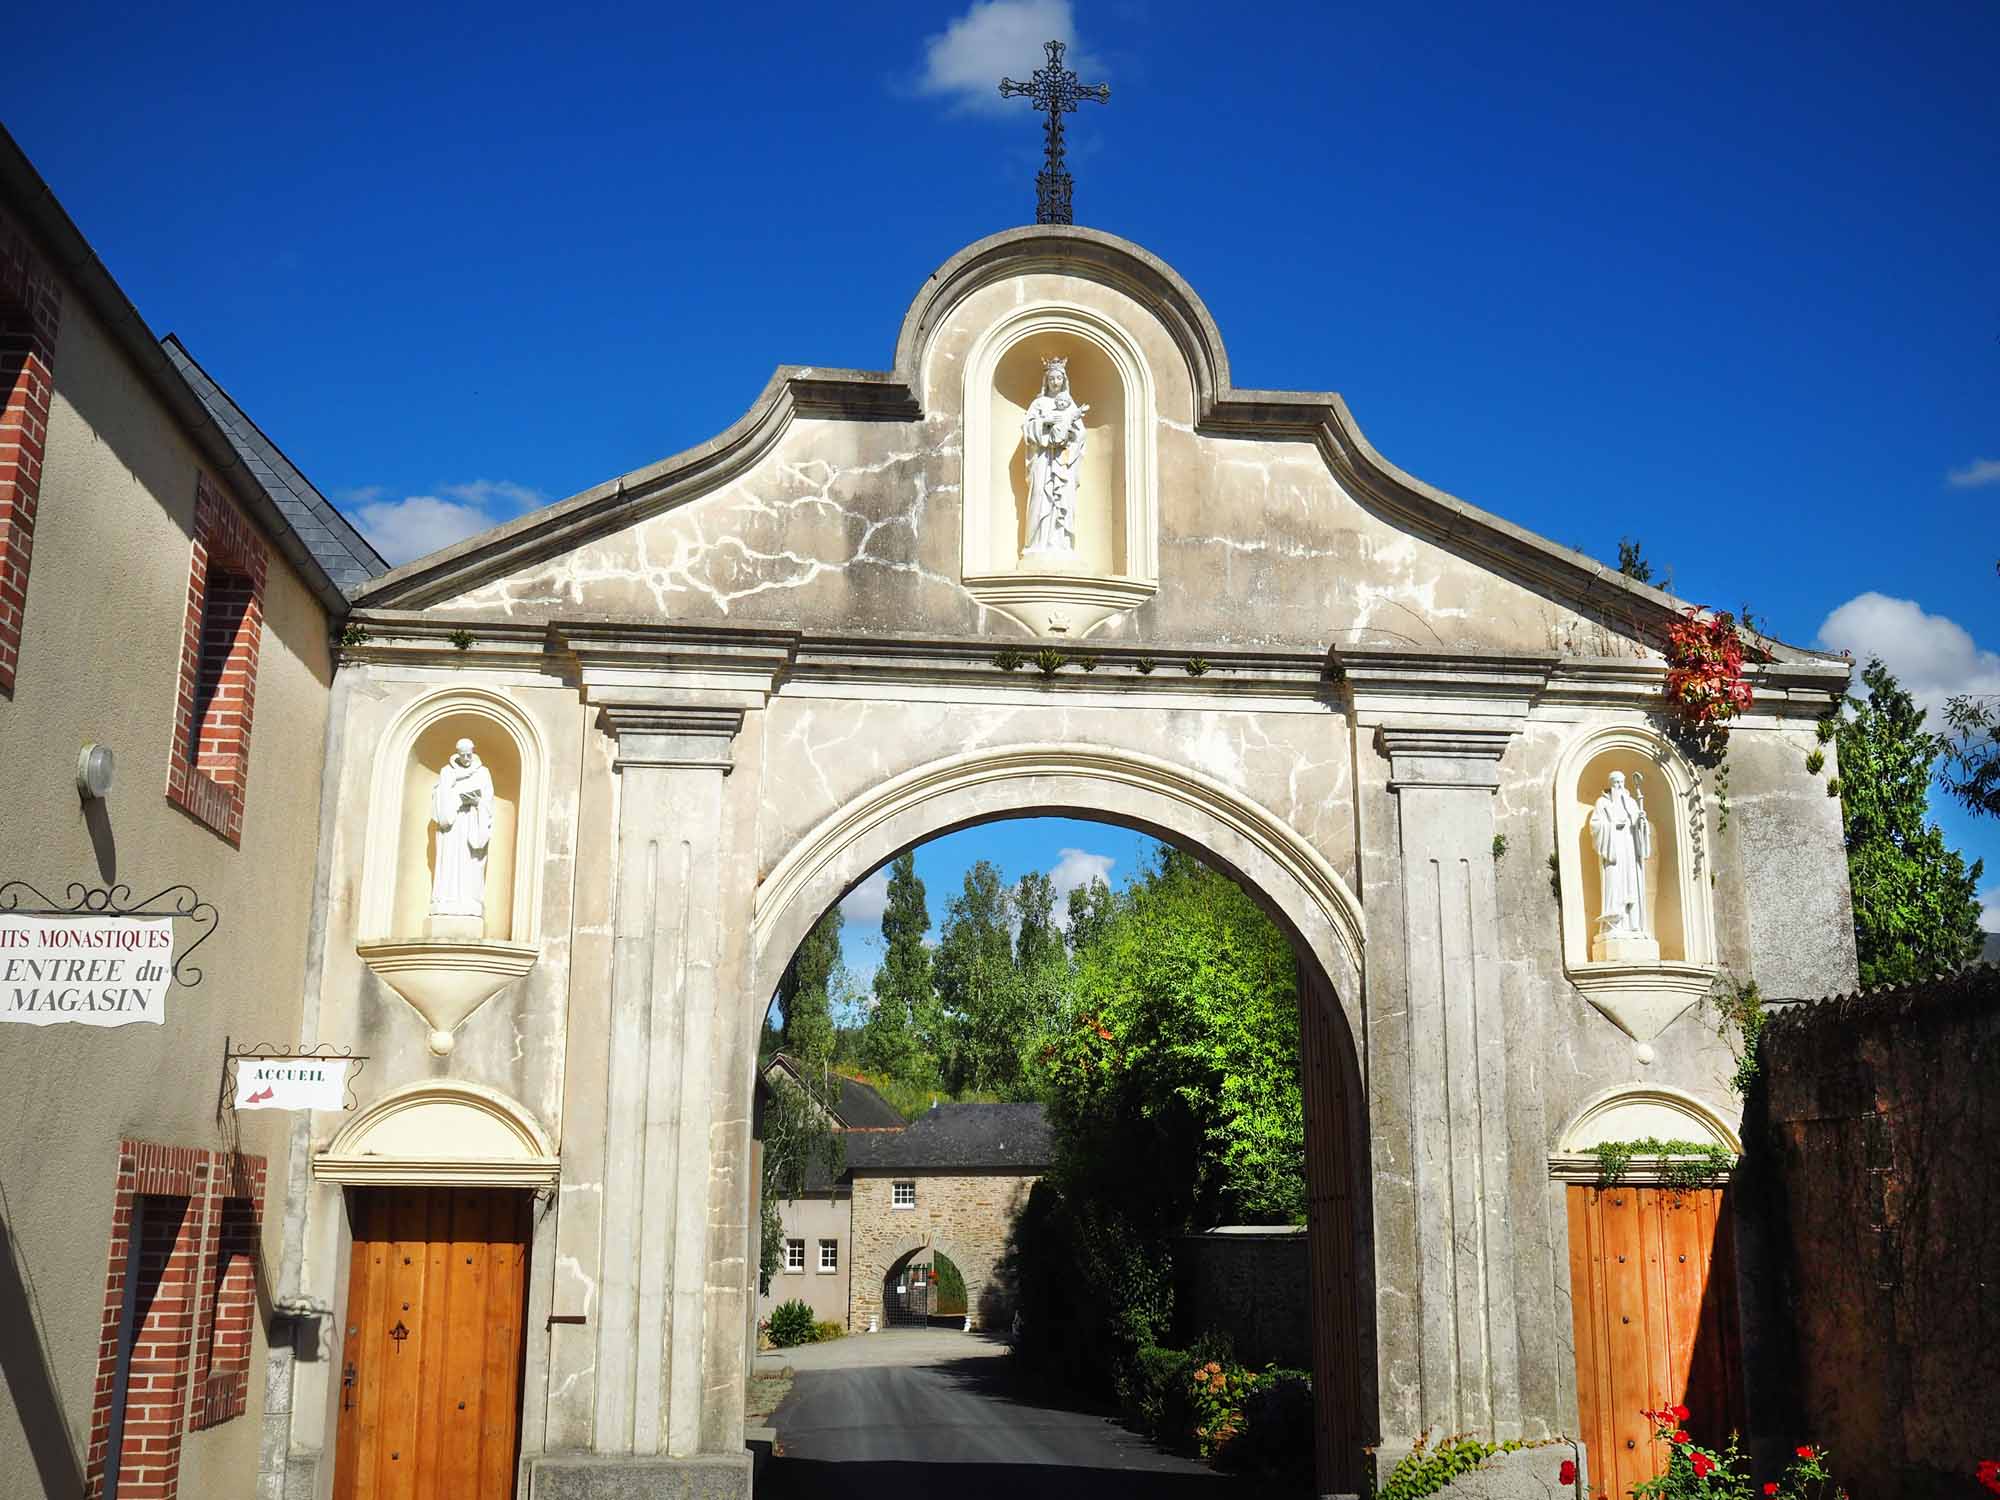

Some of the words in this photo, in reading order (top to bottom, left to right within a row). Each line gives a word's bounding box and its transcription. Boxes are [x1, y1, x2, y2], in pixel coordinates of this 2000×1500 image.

[0, 930, 30, 948] ITS
[38, 930, 170, 951] MONASTIQUES
[1, 959, 126, 981] ENTREE
[136, 960, 164, 981] du
[7, 989, 152, 1012] MAGASIN
[254, 1069, 325, 1082] ACCUEIL
